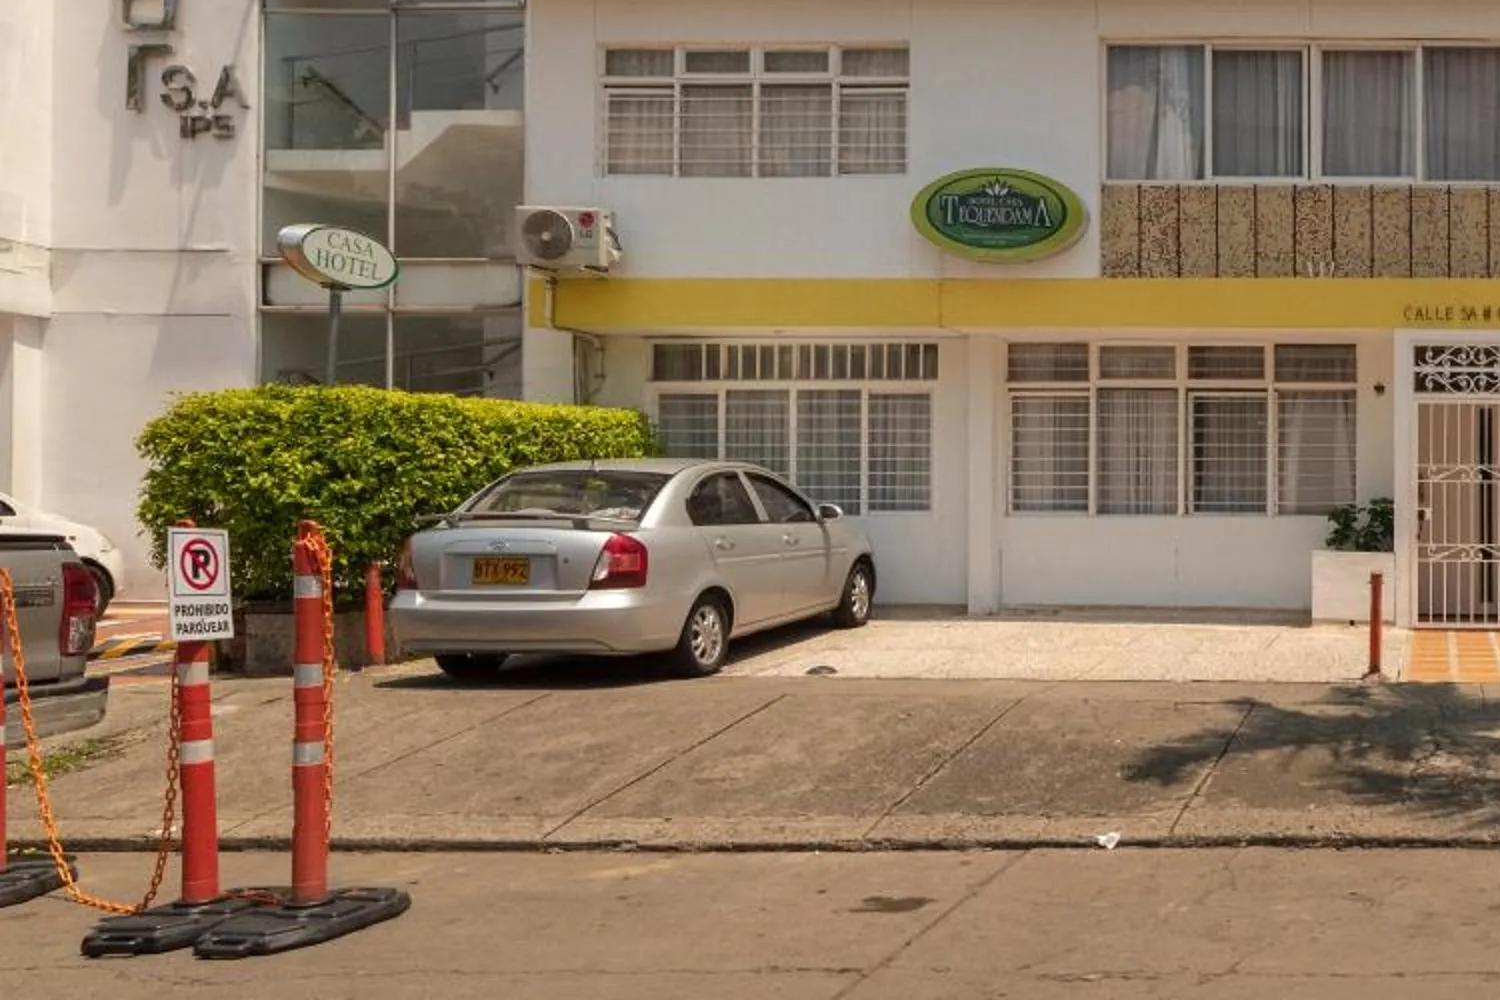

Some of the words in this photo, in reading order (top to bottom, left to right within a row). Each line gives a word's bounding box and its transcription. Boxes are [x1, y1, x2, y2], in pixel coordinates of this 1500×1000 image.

[179, 114, 235, 139] IPS
[327, 231, 374, 258] CASA
[312, 247, 383, 280] HOTEL
[1402, 304, 1455, 322] CALLE
[174, 603, 229, 617] PROHIBIDO
[176, 619, 231, 635] PARQUEAR
